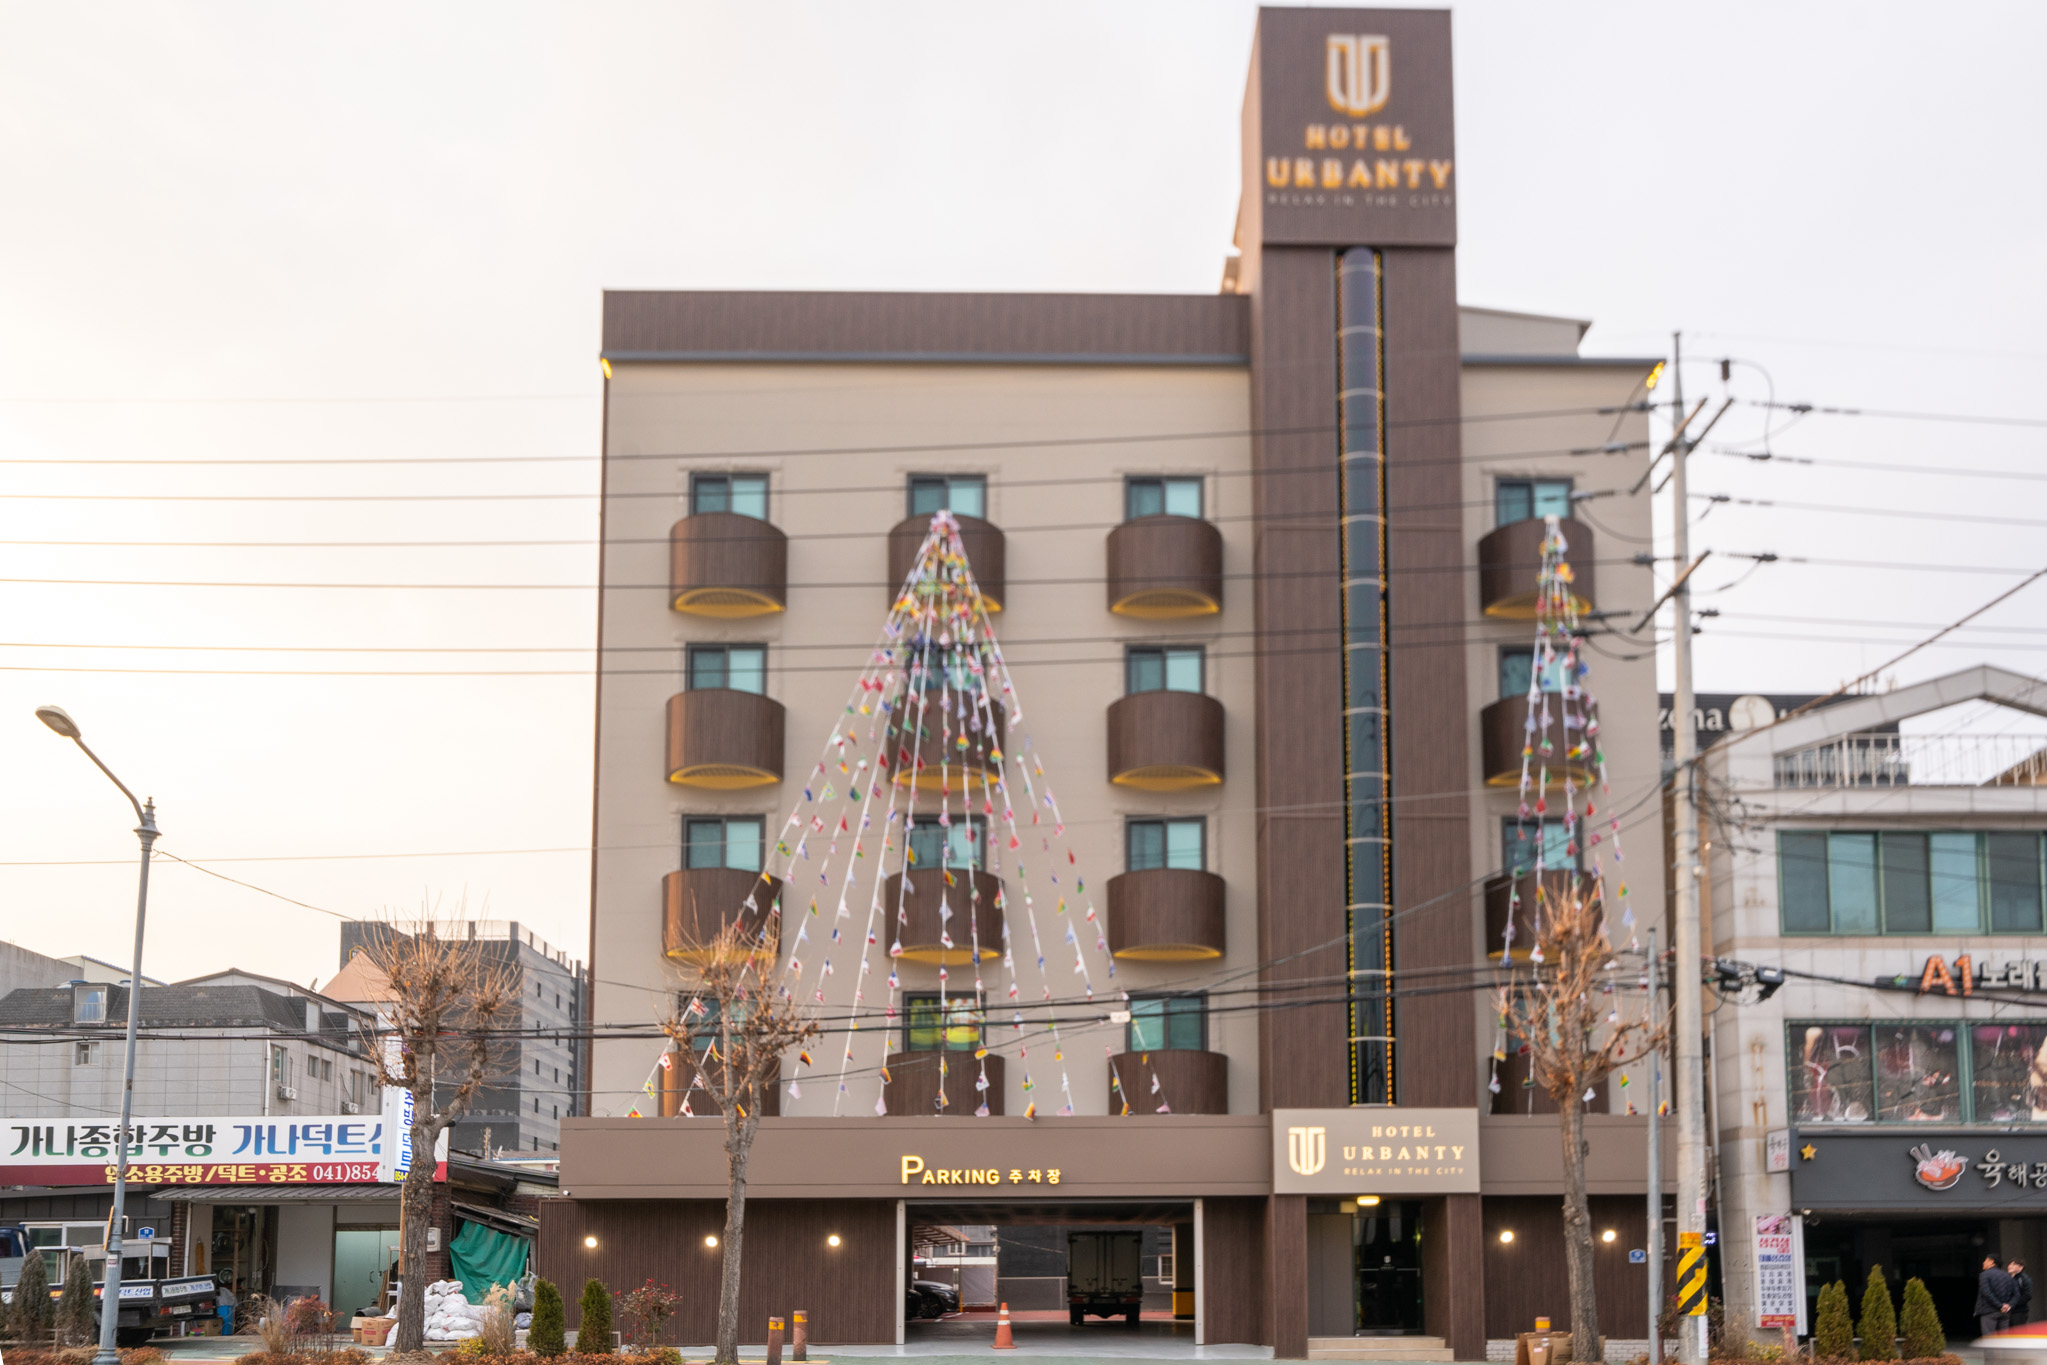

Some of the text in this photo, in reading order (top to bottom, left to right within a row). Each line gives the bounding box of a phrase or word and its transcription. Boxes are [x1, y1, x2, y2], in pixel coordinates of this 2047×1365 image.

[1305, 124, 1411, 151] HOTEL
[1266, 157, 1452, 189] URBANTY
[1920, 953, 1973, 996] A1
[10, 1124, 217, 1158] 가나종합주방
[1371, 1125, 1436, 1138] HOTEL
[1342, 1145, 1465, 1161] URBANTY
[901, 1155, 1000, 1185] PARKING
[1343, 1167, 1464, 1175] RELAX IN THE CITY
